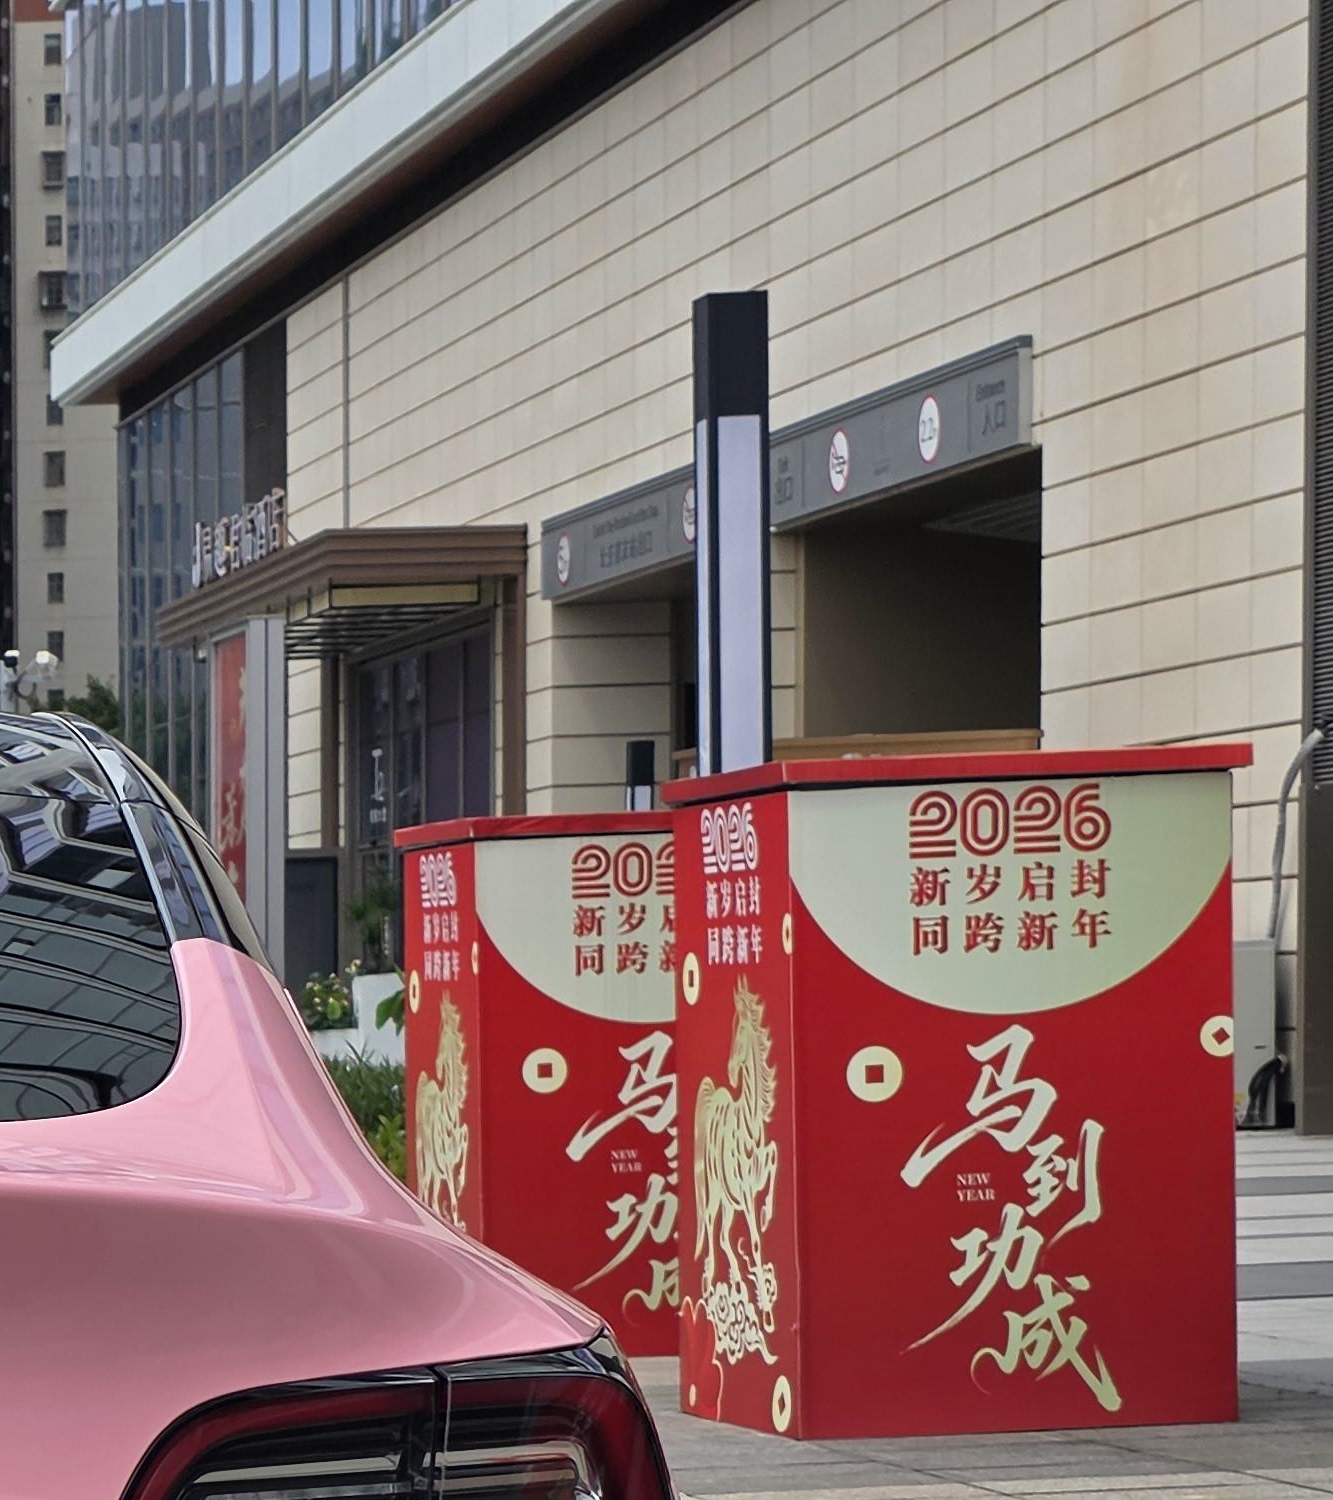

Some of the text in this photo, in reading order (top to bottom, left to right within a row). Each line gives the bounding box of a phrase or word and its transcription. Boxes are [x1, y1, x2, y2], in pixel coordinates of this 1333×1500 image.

[981, 400, 1006, 435] 入口
[700, 802, 758, 874] 2026
[908, 783, 1112, 859] 2026
[419, 851, 457, 908] 2026
[706, 875, 761, 919] 新岁启封
[909, 858, 1112, 907] 新岁启封
[707, 924, 763, 966] 同跨新年
[912, 908, 1112, 956] 同跨新年
[611, 1150, 639, 1161] NEW
[611, 1161, 643, 1174] YEAR
[956, 1173, 992, 1187] NEW
[956, 1187, 996, 1202] YEAR
